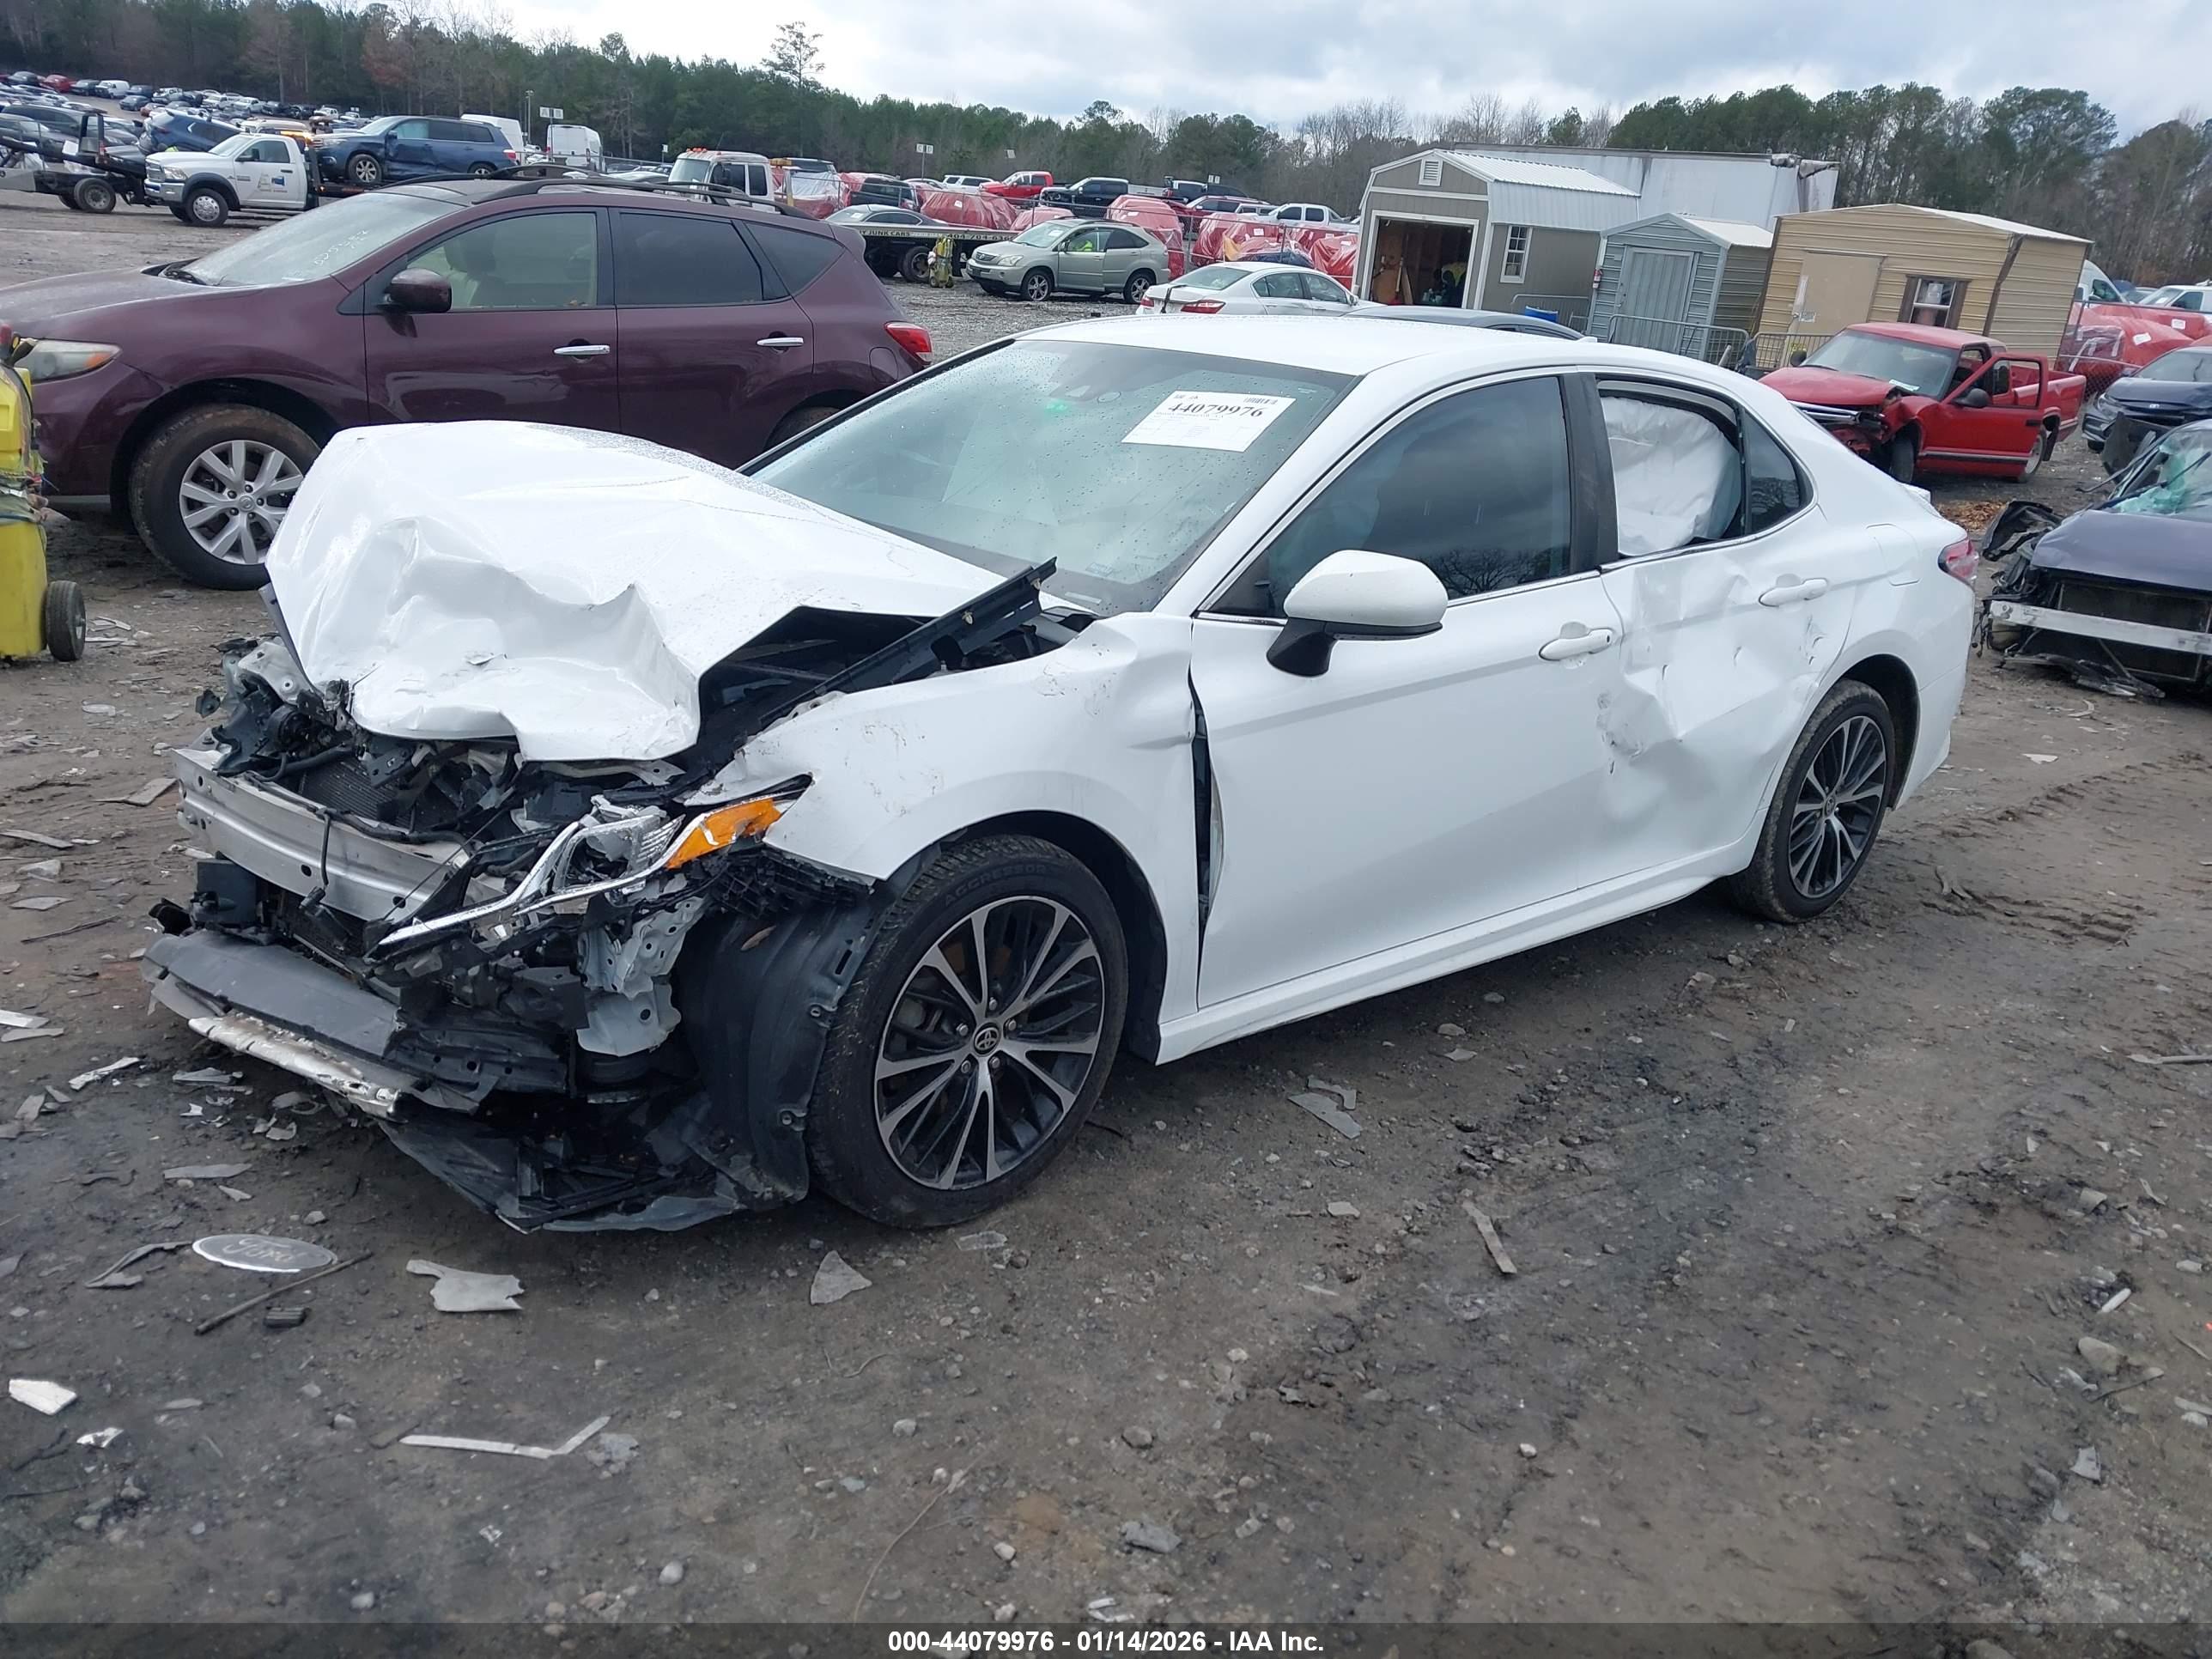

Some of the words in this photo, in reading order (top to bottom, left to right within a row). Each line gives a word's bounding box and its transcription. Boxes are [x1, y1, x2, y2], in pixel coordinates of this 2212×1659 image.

[1168, 402, 1268, 417] 44079976
[945, 864, 1046, 908] AGGRESSOR
[222, 1237, 308, 1263] Ford
